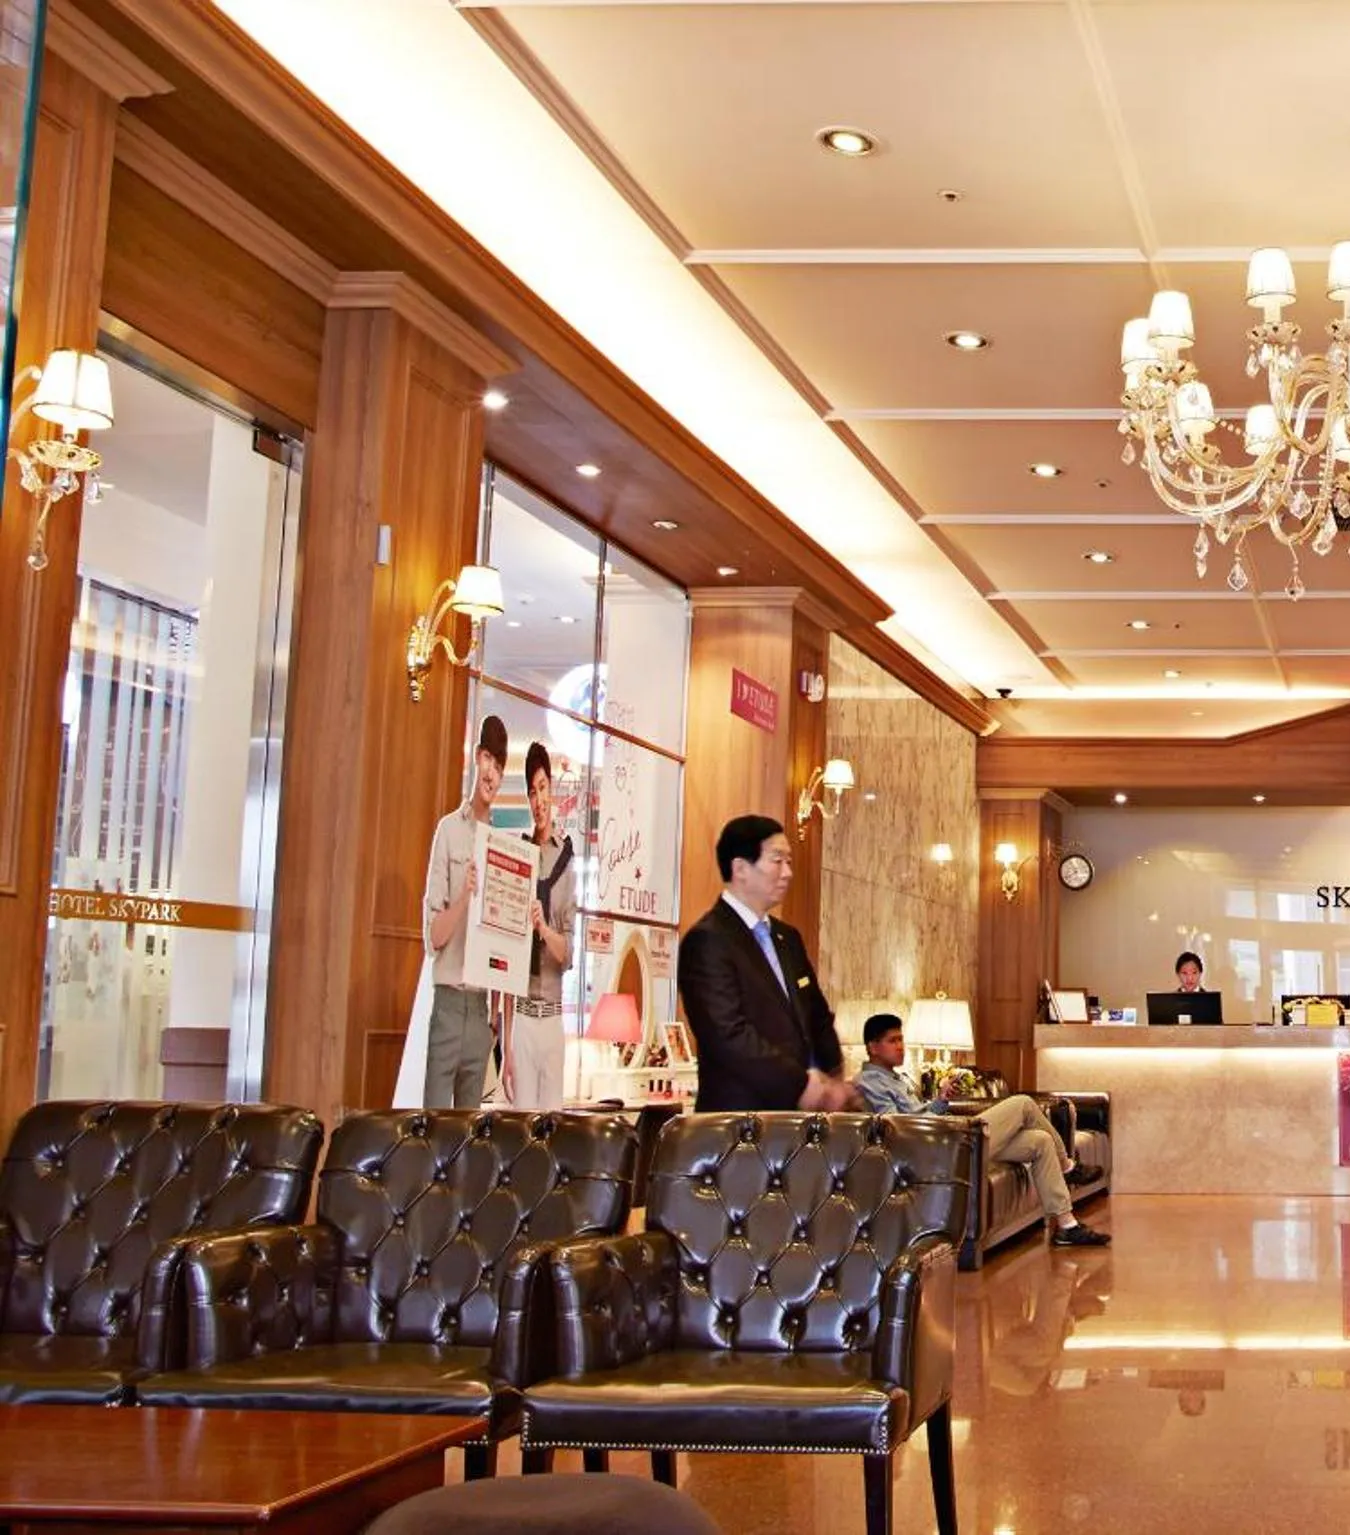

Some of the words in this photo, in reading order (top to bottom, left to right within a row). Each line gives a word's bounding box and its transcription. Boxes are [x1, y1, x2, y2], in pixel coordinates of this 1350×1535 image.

[50, 893, 105, 916] HOTEL
[109, 898, 182, 922] SKYPARK
[619, 886, 657, 915] ETUDE
